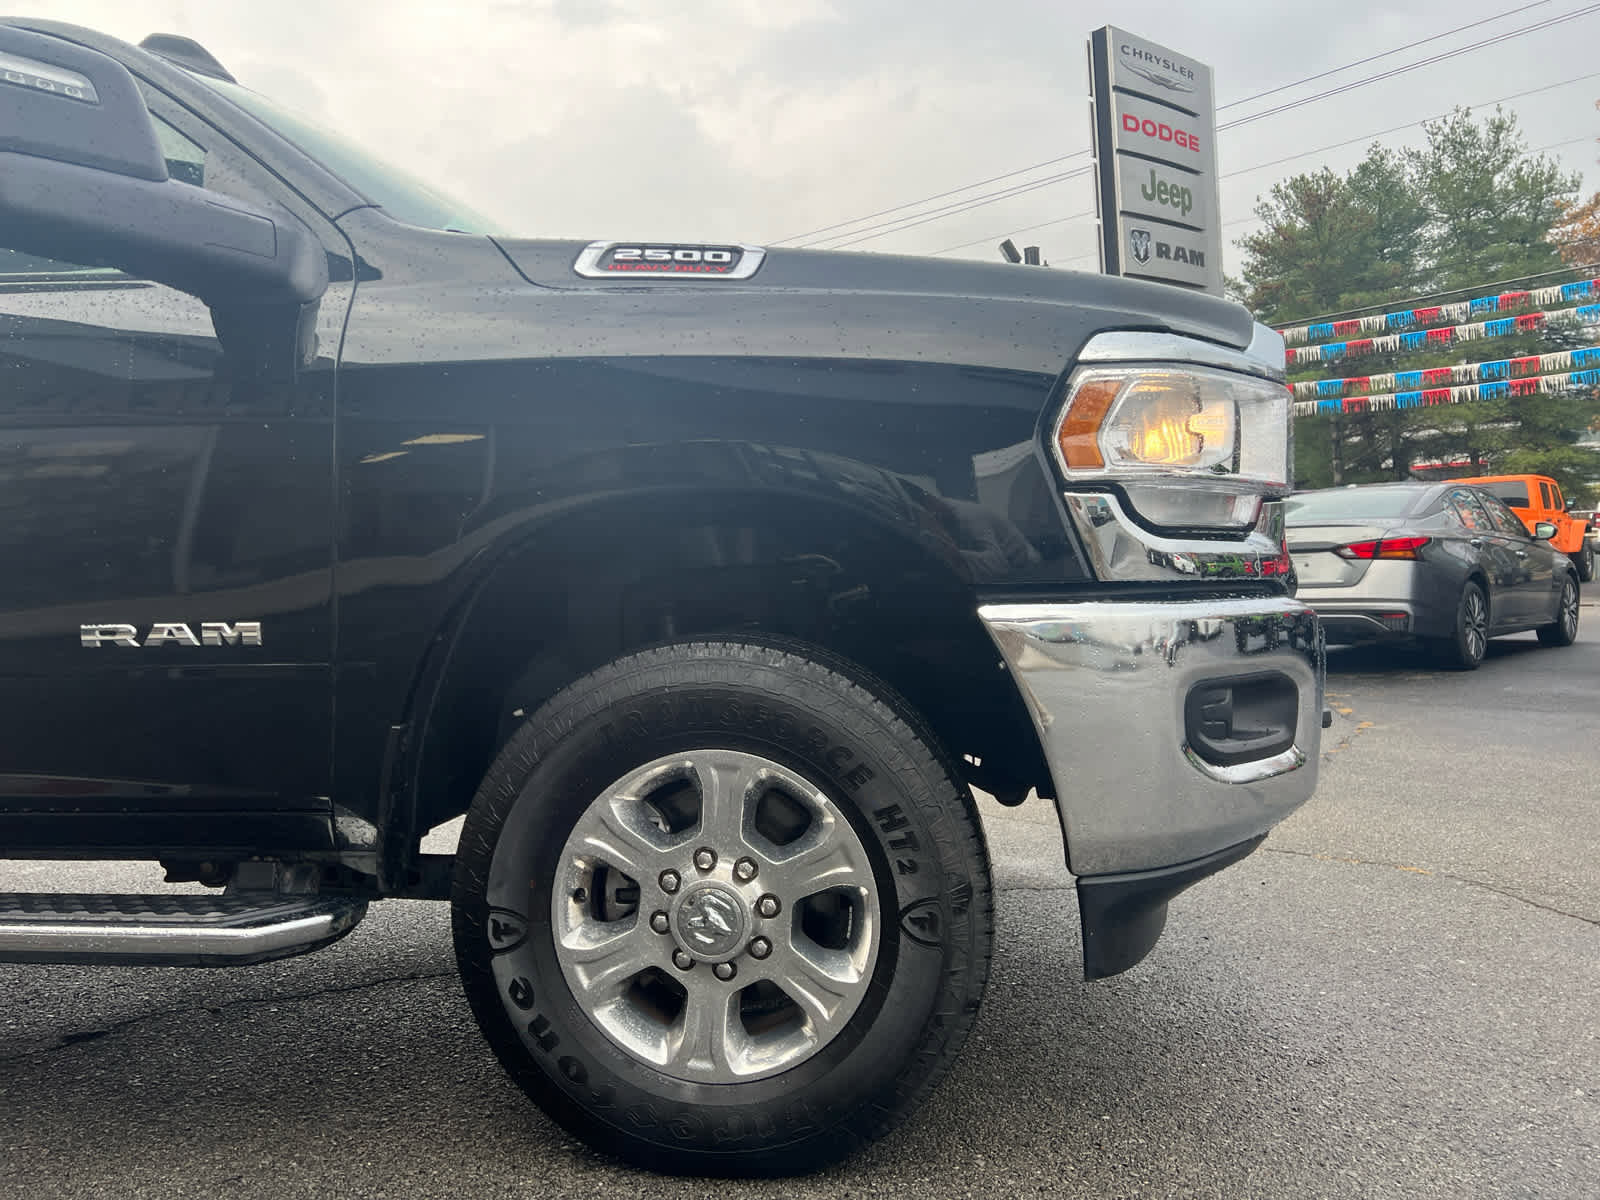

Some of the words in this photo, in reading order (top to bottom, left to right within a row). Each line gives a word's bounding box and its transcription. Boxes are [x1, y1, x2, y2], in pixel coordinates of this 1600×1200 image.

[1120, 44, 1195, 81] CHRYSLER
[1122, 113, 1201, 153] DODGE
[1141, 169, 1193, 217] Jeep
[613, 248, 732, 262] 2500
[1155, 242, 1206, 268] RAM
[608, 263, 671, 272] HEAVY
[674, 264, 728, 274] DUTY
[80, 622, 264, 648] RAM
